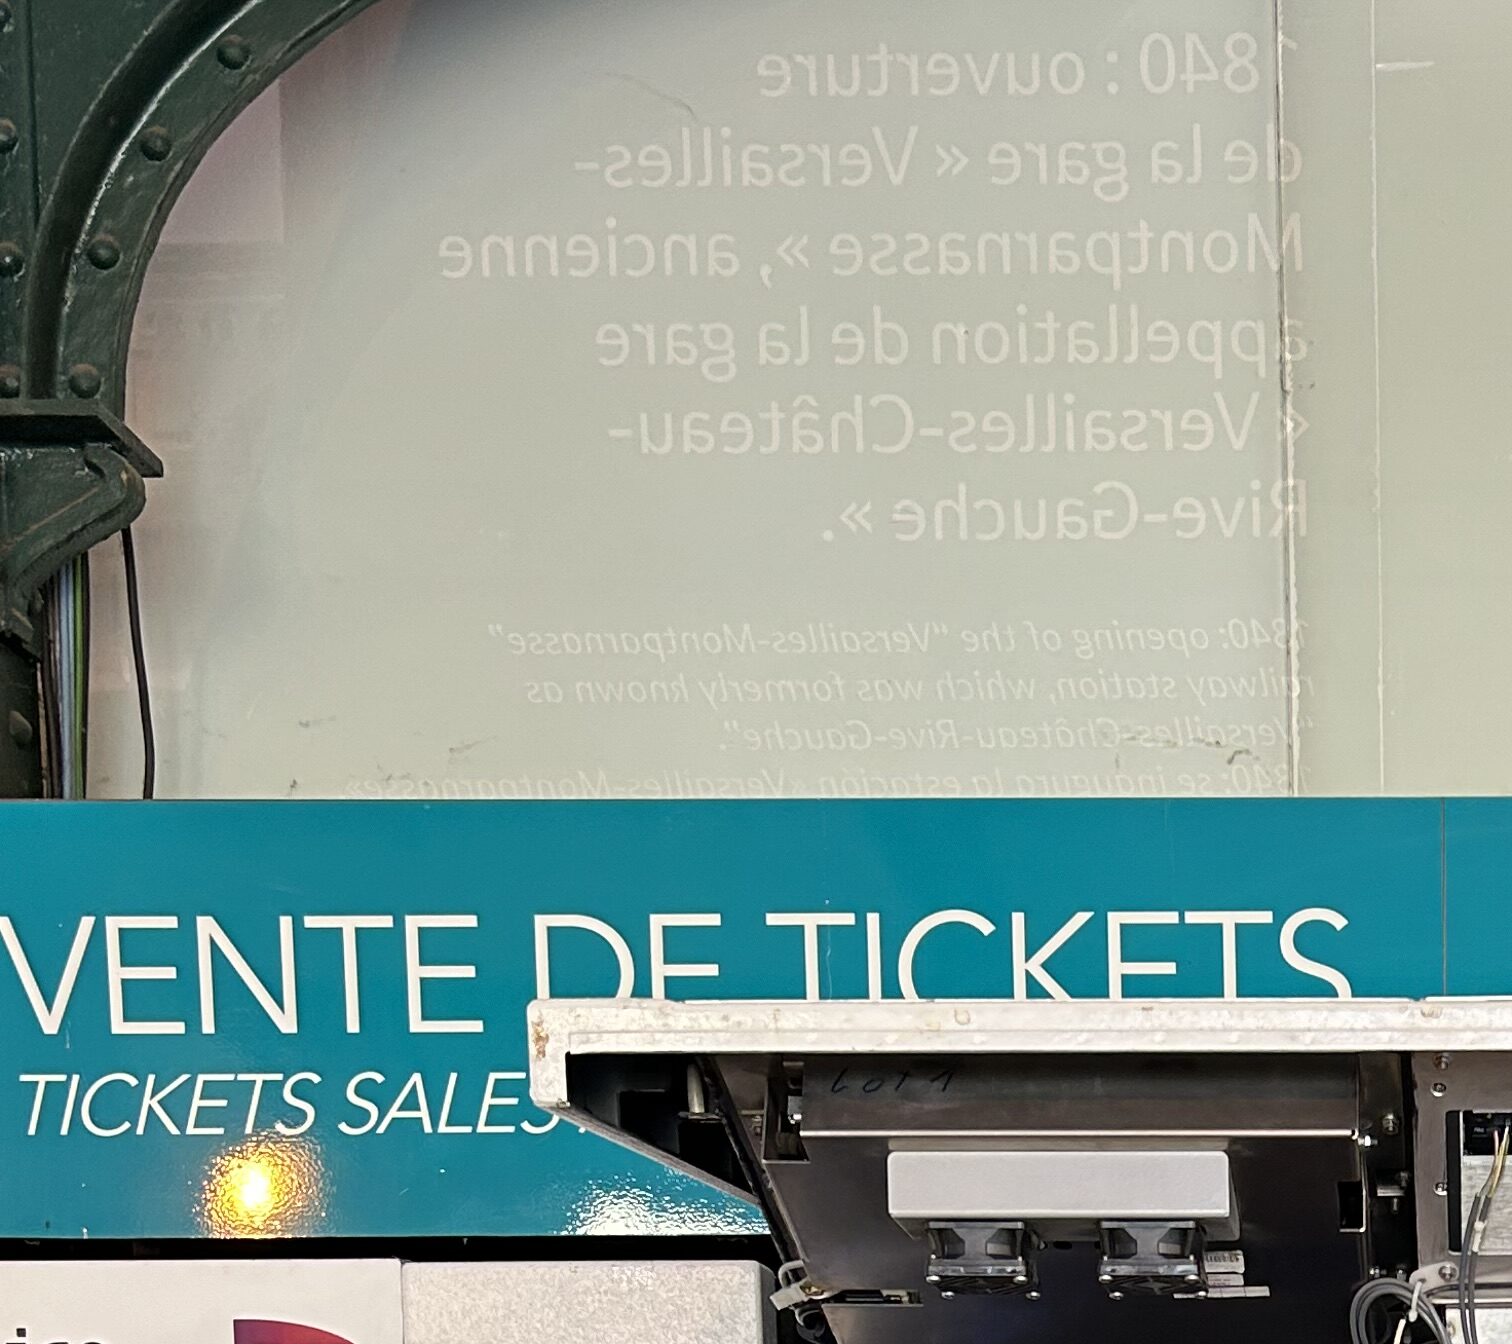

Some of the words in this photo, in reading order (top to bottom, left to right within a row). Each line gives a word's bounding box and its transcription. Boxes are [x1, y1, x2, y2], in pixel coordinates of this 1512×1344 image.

[0, 914, 484, 1036] VENTE
[534, 913, 722, 1000] DE
[765, 907, 1352, 1000] TICKETS
[19, 1071, 321, 1137] TICKETS
